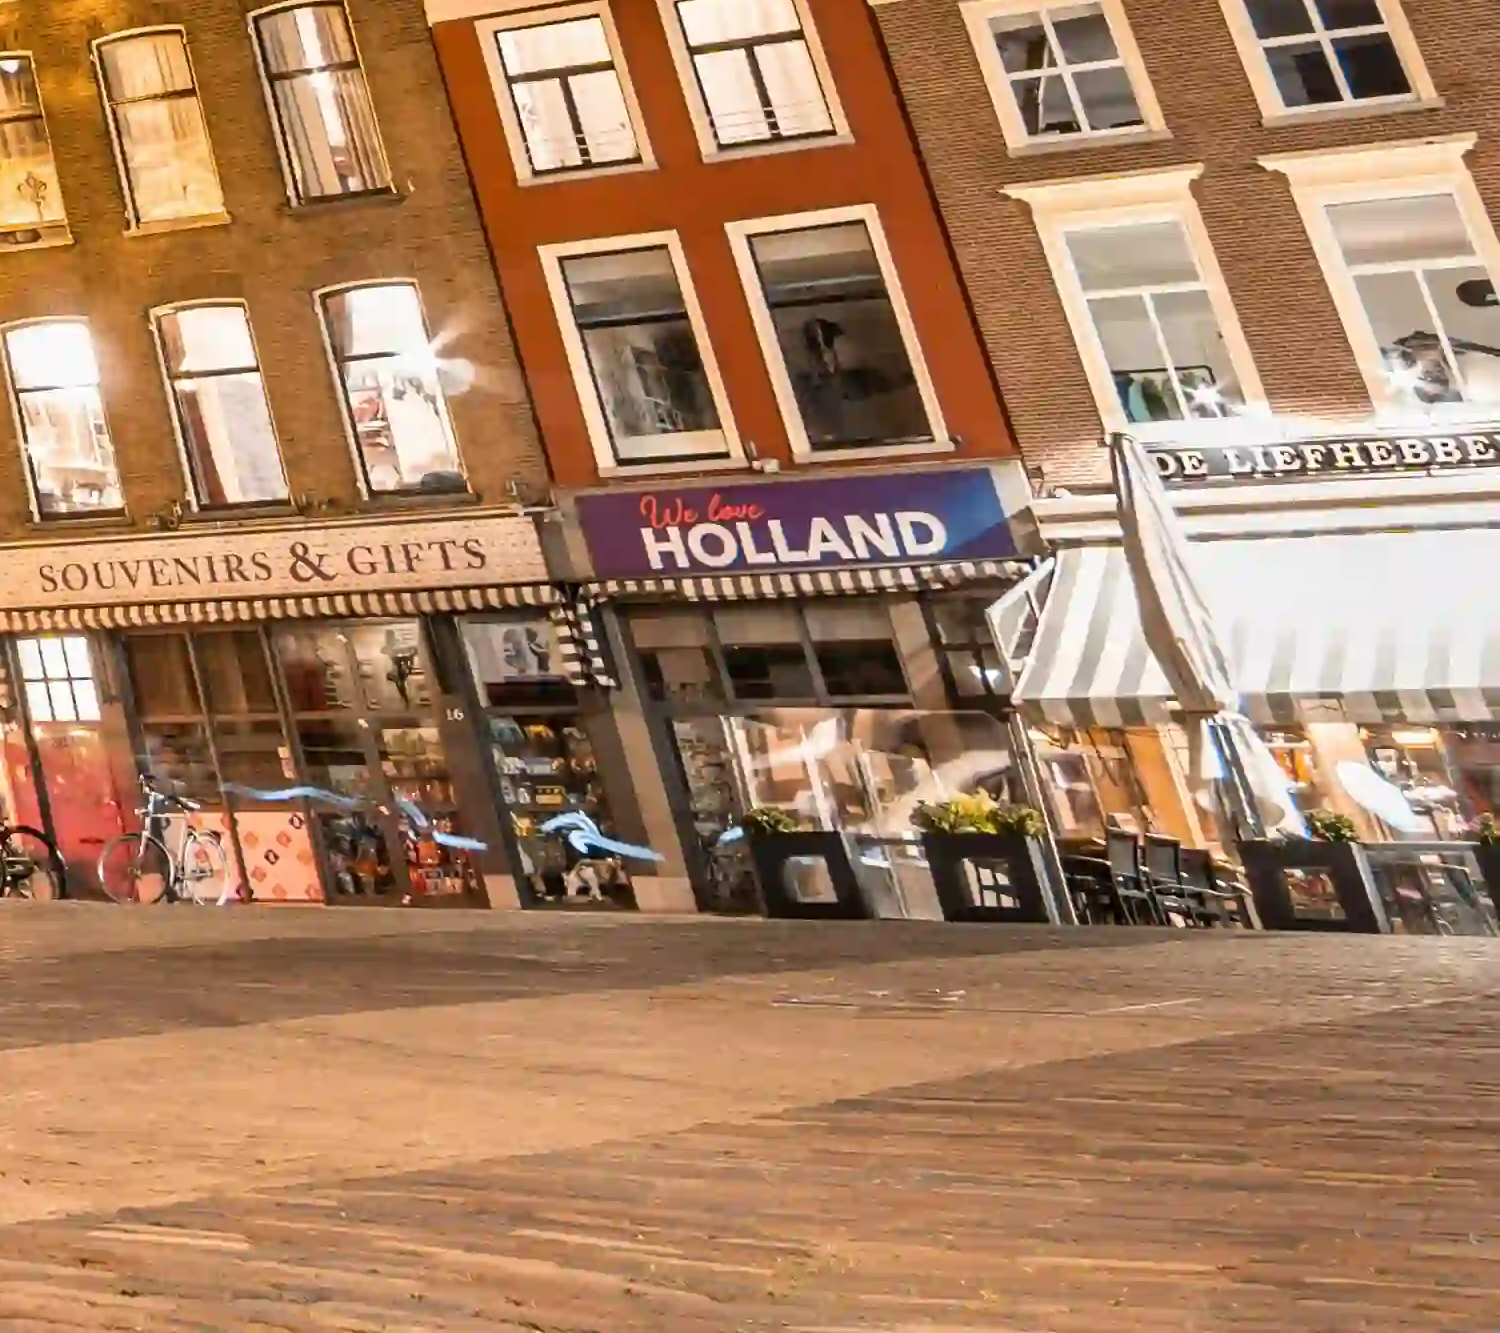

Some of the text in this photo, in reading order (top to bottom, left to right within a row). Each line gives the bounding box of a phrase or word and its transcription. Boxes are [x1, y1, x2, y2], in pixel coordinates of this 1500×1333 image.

[1150, 434, 1500, 475] DE LIEFHEBBE
[640, 493, 764, 529] We love
[640, 511, 947, 570] HOLLAND
[38, 538, 487, 593] SOUVENIRS & GIFTS
[446, 708, 464, 721] 16
